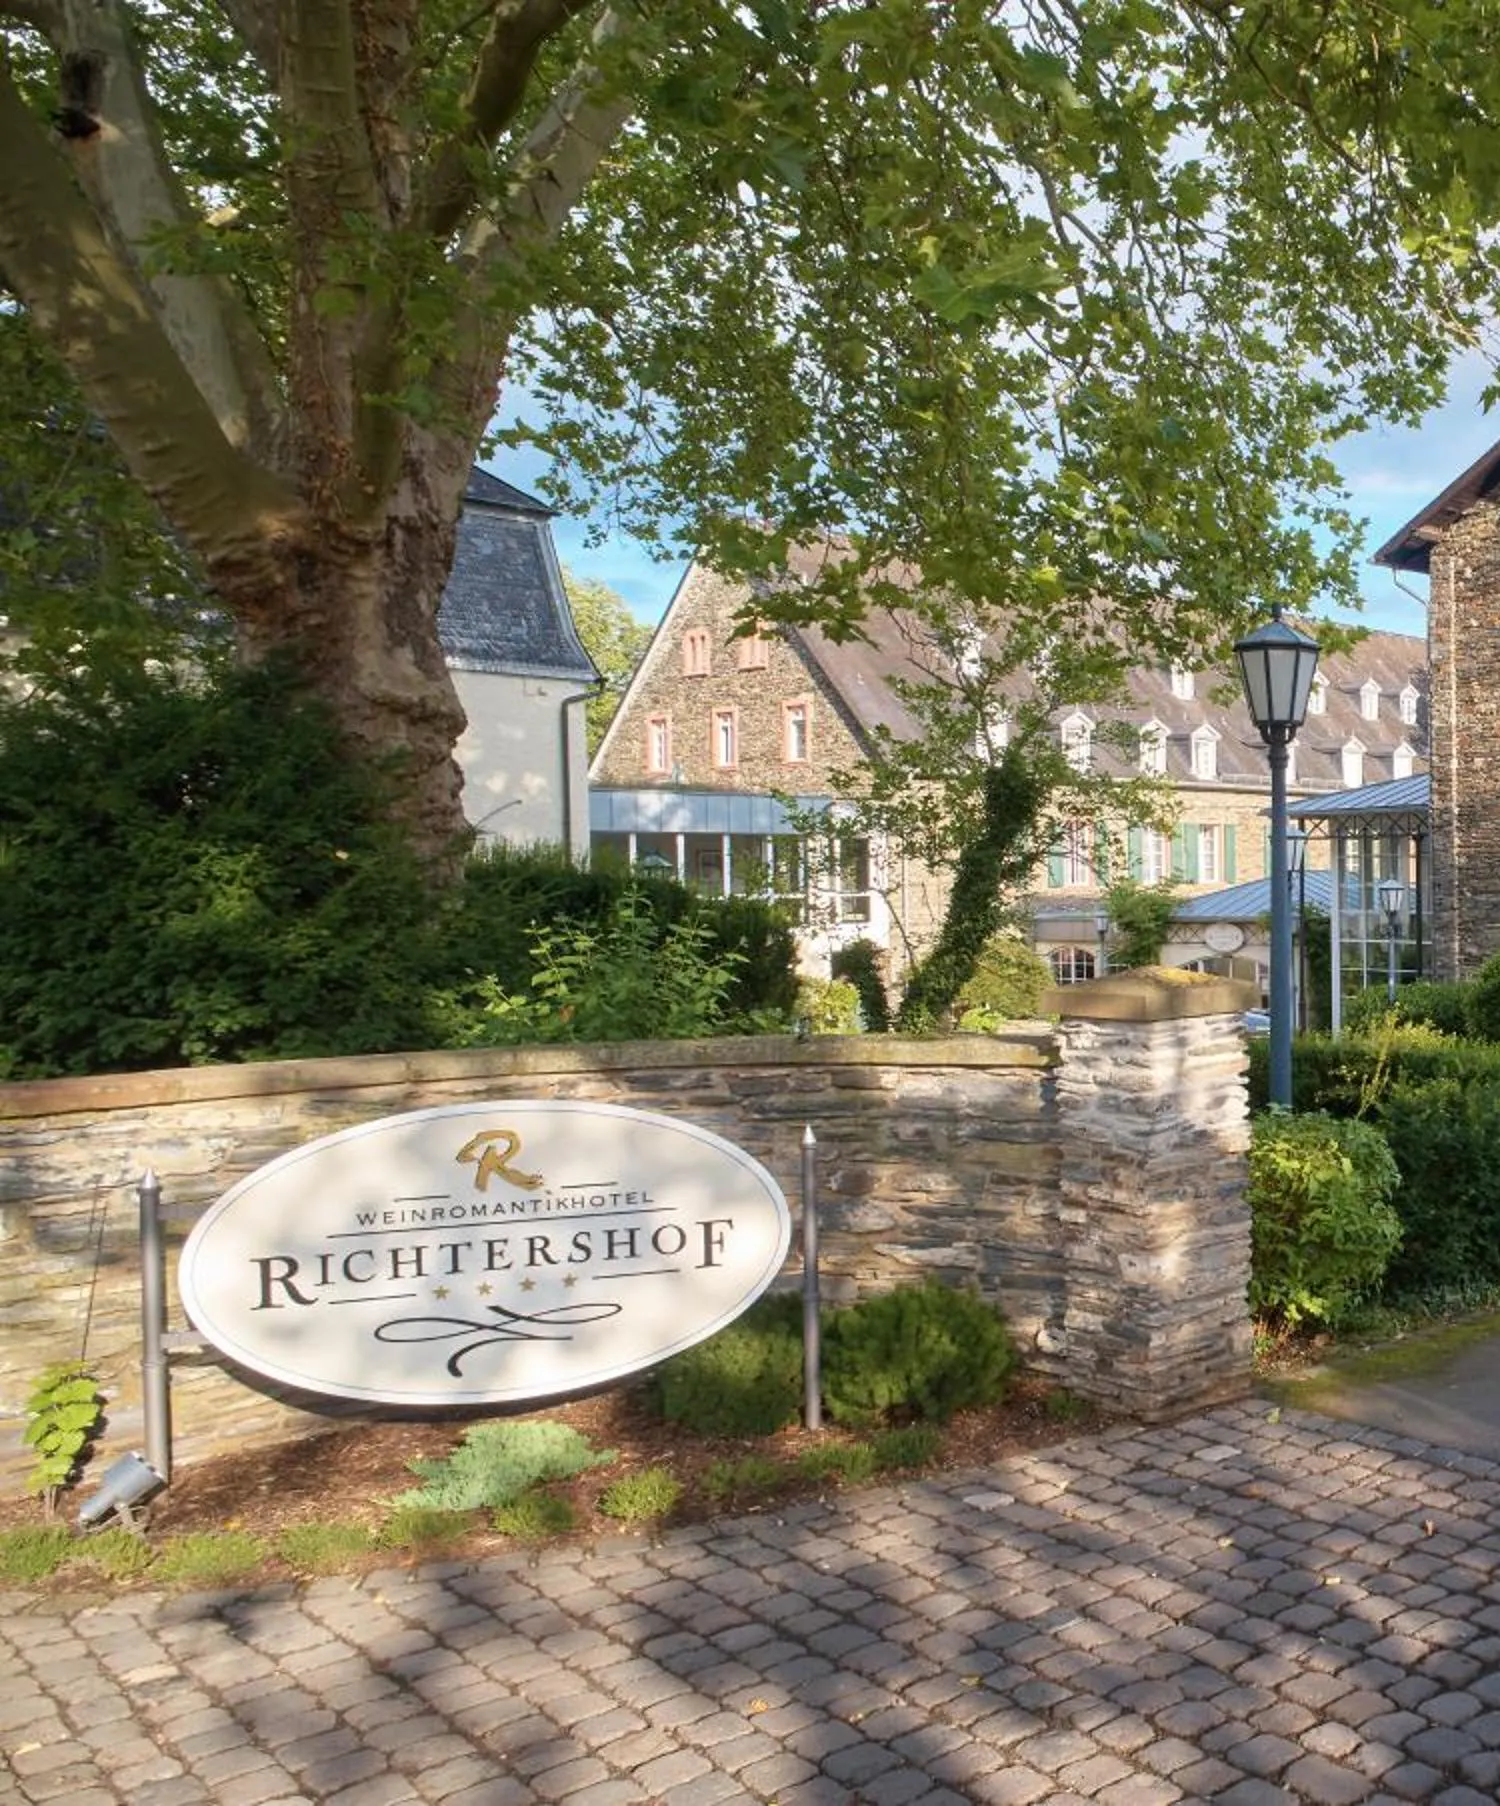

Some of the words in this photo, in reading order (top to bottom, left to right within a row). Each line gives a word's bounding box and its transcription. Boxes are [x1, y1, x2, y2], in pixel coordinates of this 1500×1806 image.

[456, 1129, 545, 1191] R
[356, 1191, 655, 1226] WEINROMANTIKHOTEL
[249, 1218, 735, 1311] RICHTERSHOF
